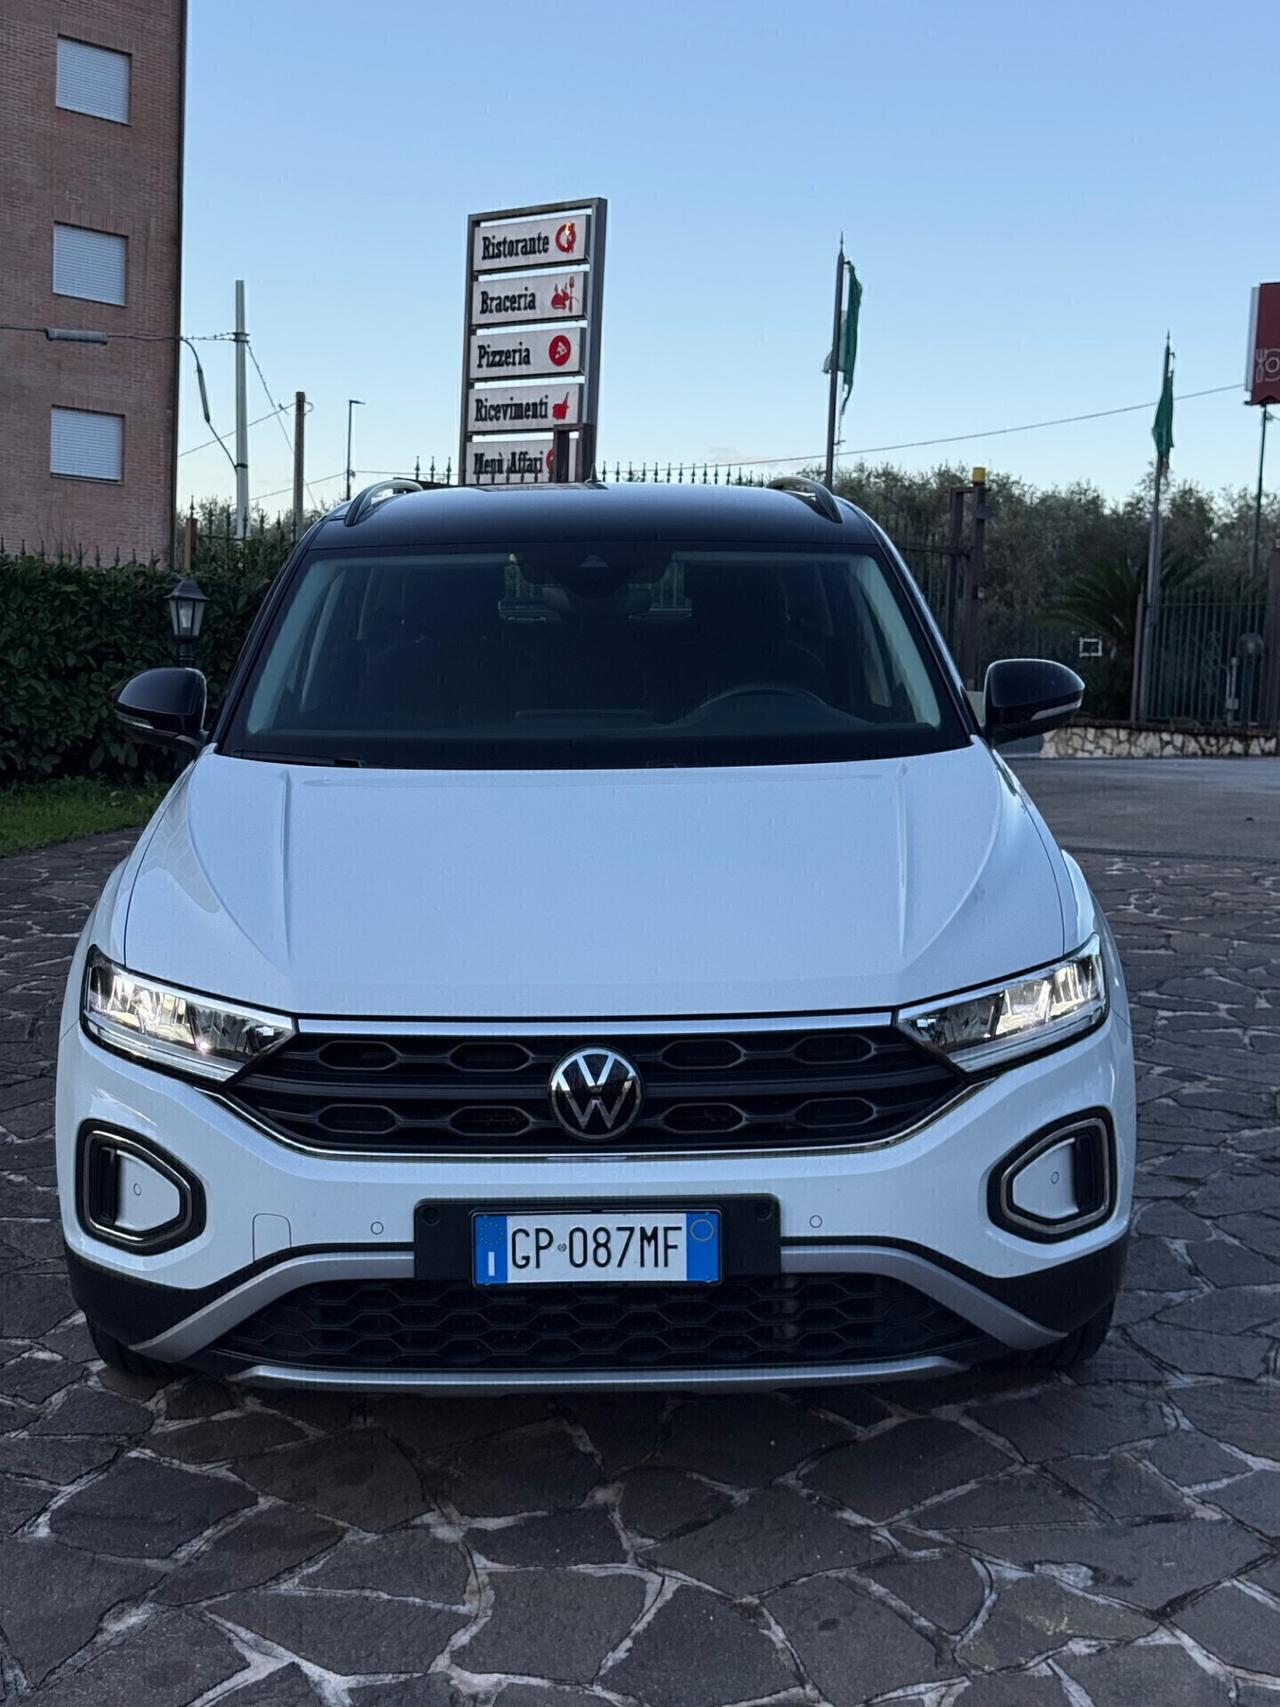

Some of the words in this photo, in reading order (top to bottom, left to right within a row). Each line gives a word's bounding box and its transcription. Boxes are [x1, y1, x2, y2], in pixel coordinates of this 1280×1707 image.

[481, 232, 549, 260] Ristorante
[479, 286, 537, 315] Braceria
[477, 341, 531, 369] Pizzeria
[474, 394, 549, 422] Ricevimenti
[510, 450, 544, 474] Affari
